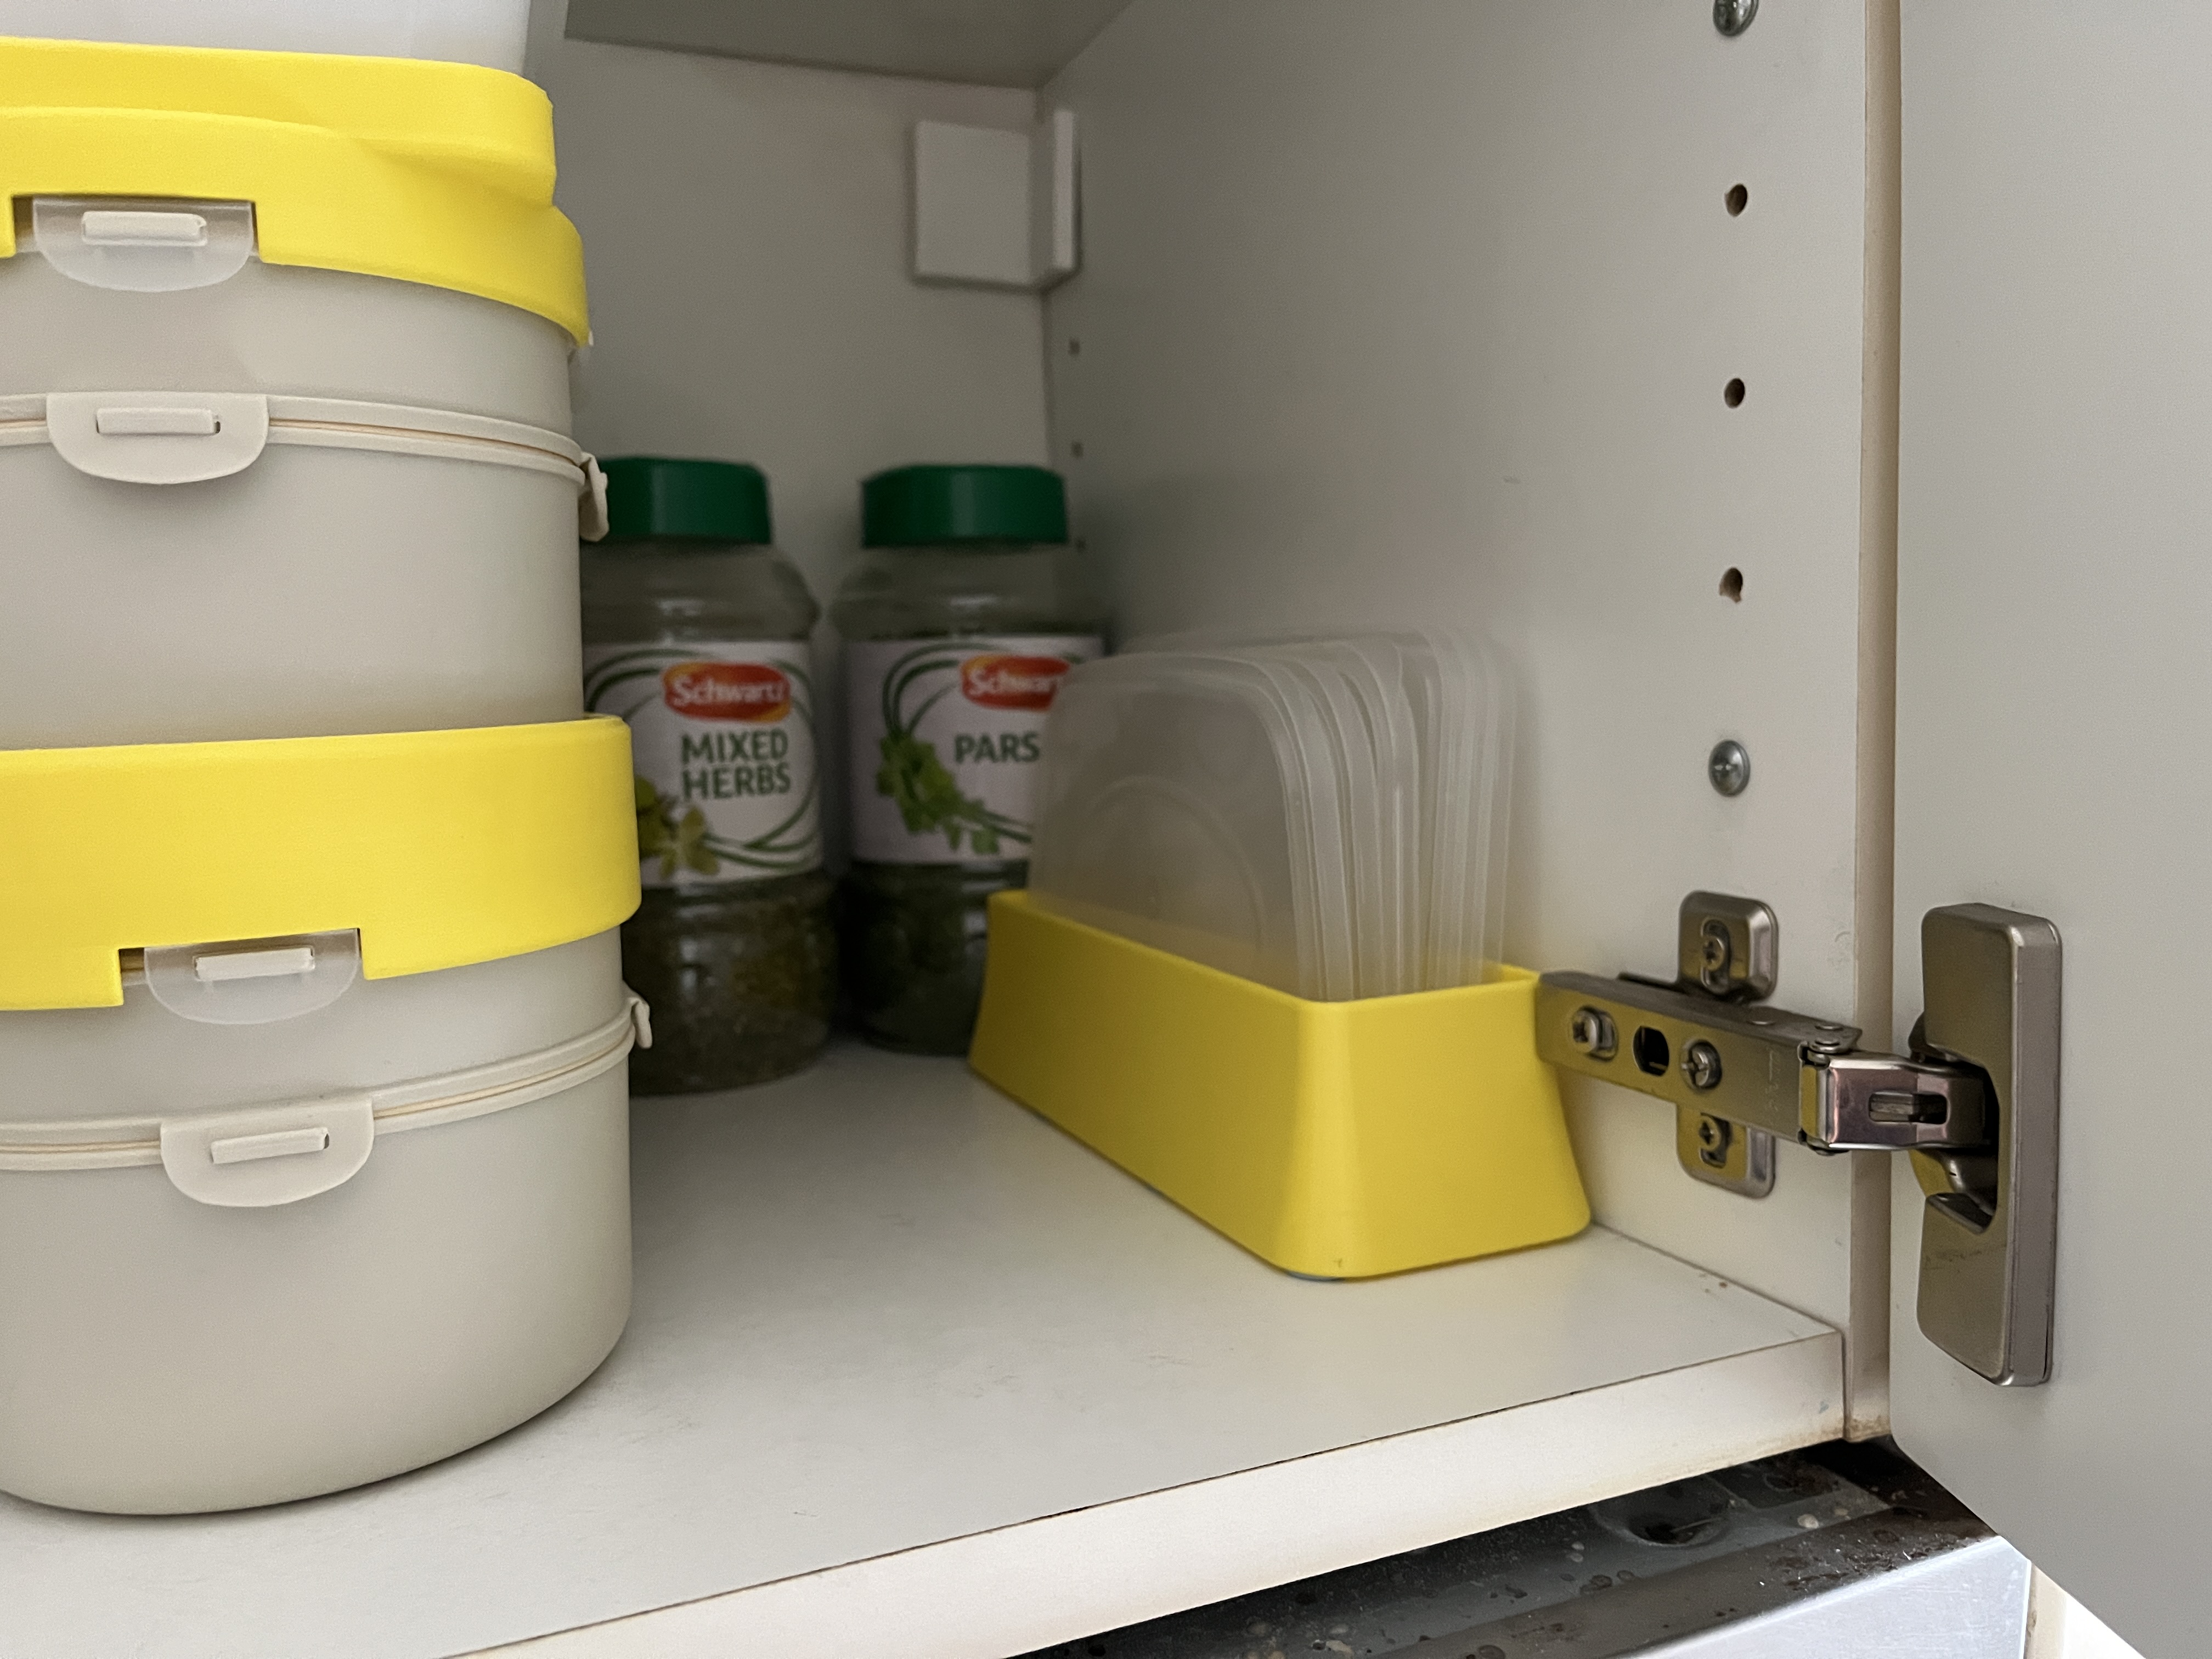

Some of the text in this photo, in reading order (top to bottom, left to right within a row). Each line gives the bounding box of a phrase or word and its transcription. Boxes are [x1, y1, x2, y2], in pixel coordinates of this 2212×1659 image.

[681, 728, 789, 764] MIXED
[954, 731, 1041, 763] PARS
[681, 762, 791, 800] HERBS
